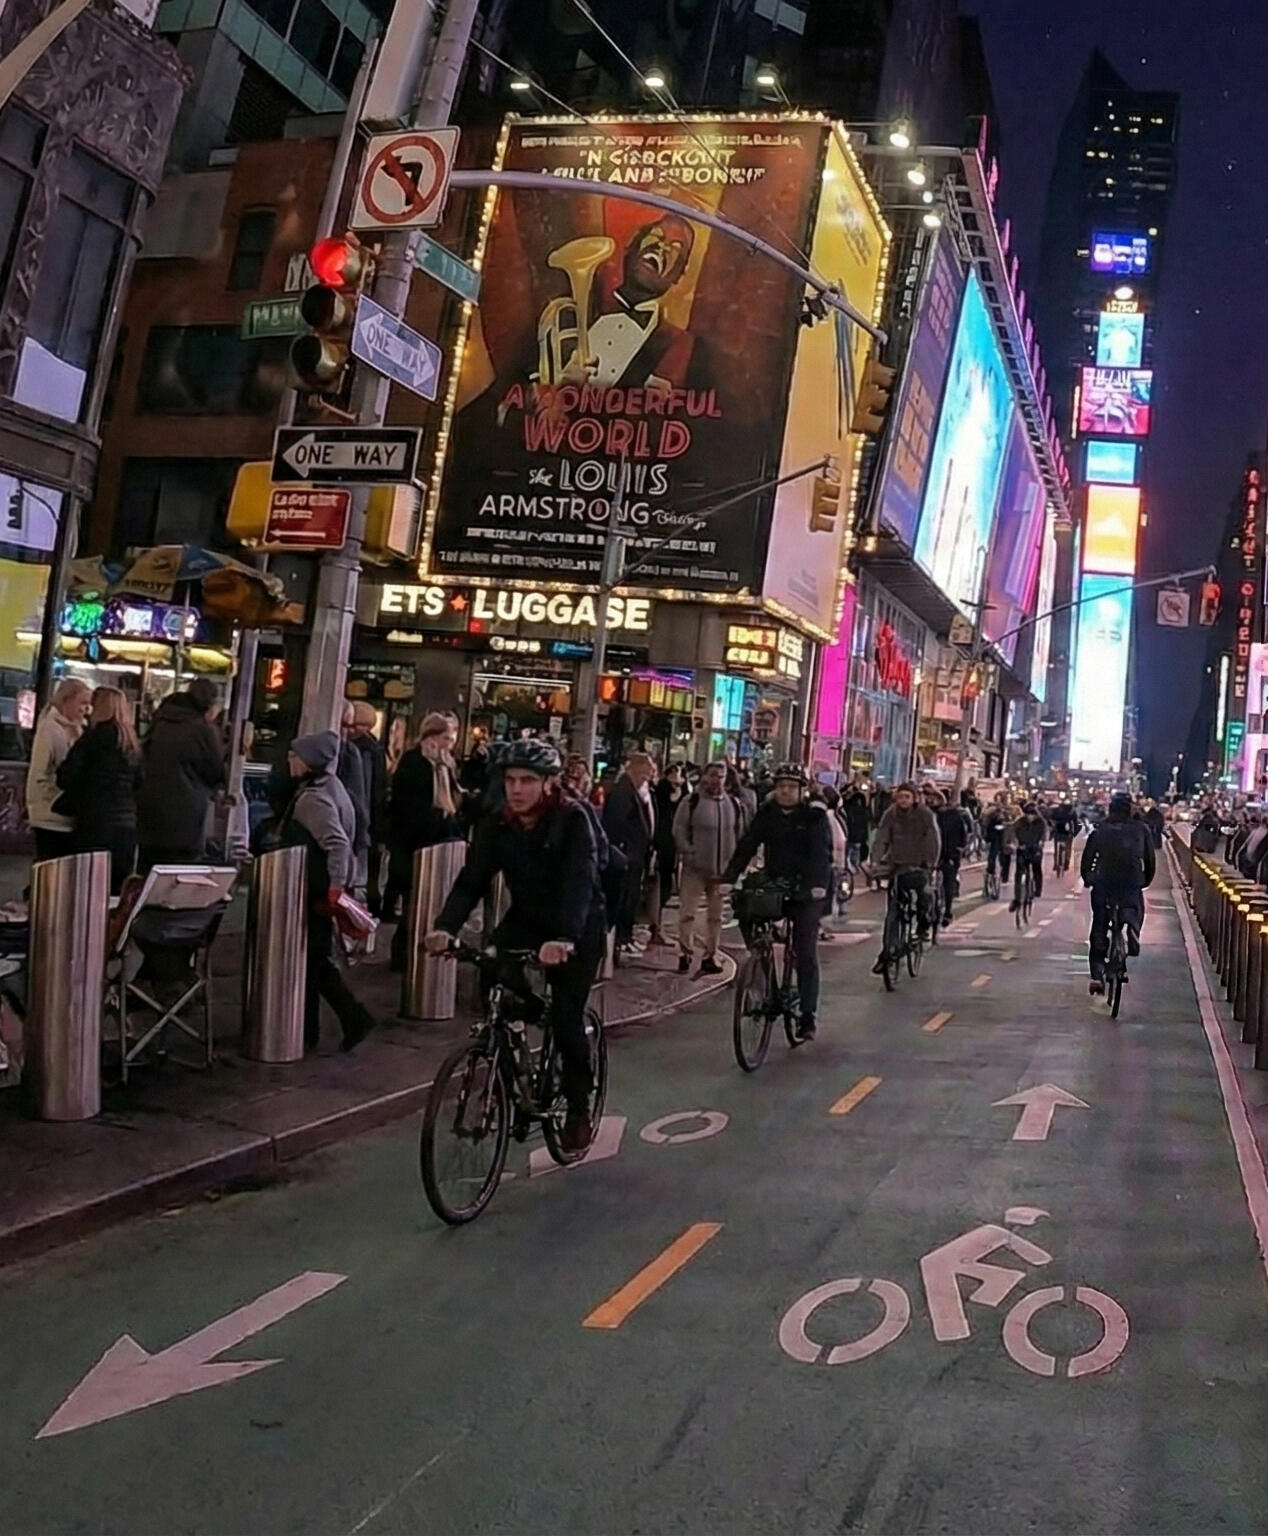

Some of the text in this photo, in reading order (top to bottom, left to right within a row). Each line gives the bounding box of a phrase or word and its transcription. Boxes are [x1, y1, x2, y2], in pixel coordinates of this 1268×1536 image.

[367, 325, 392, 355] ONE
[506, 383, 524, 409] A
[524, 411, 691, 458] WORLD
[295, 444, 397, 466] ONE WAY
[559, 458, 669, 495] LOUIS
[380, 584, 446, 616] ETS
